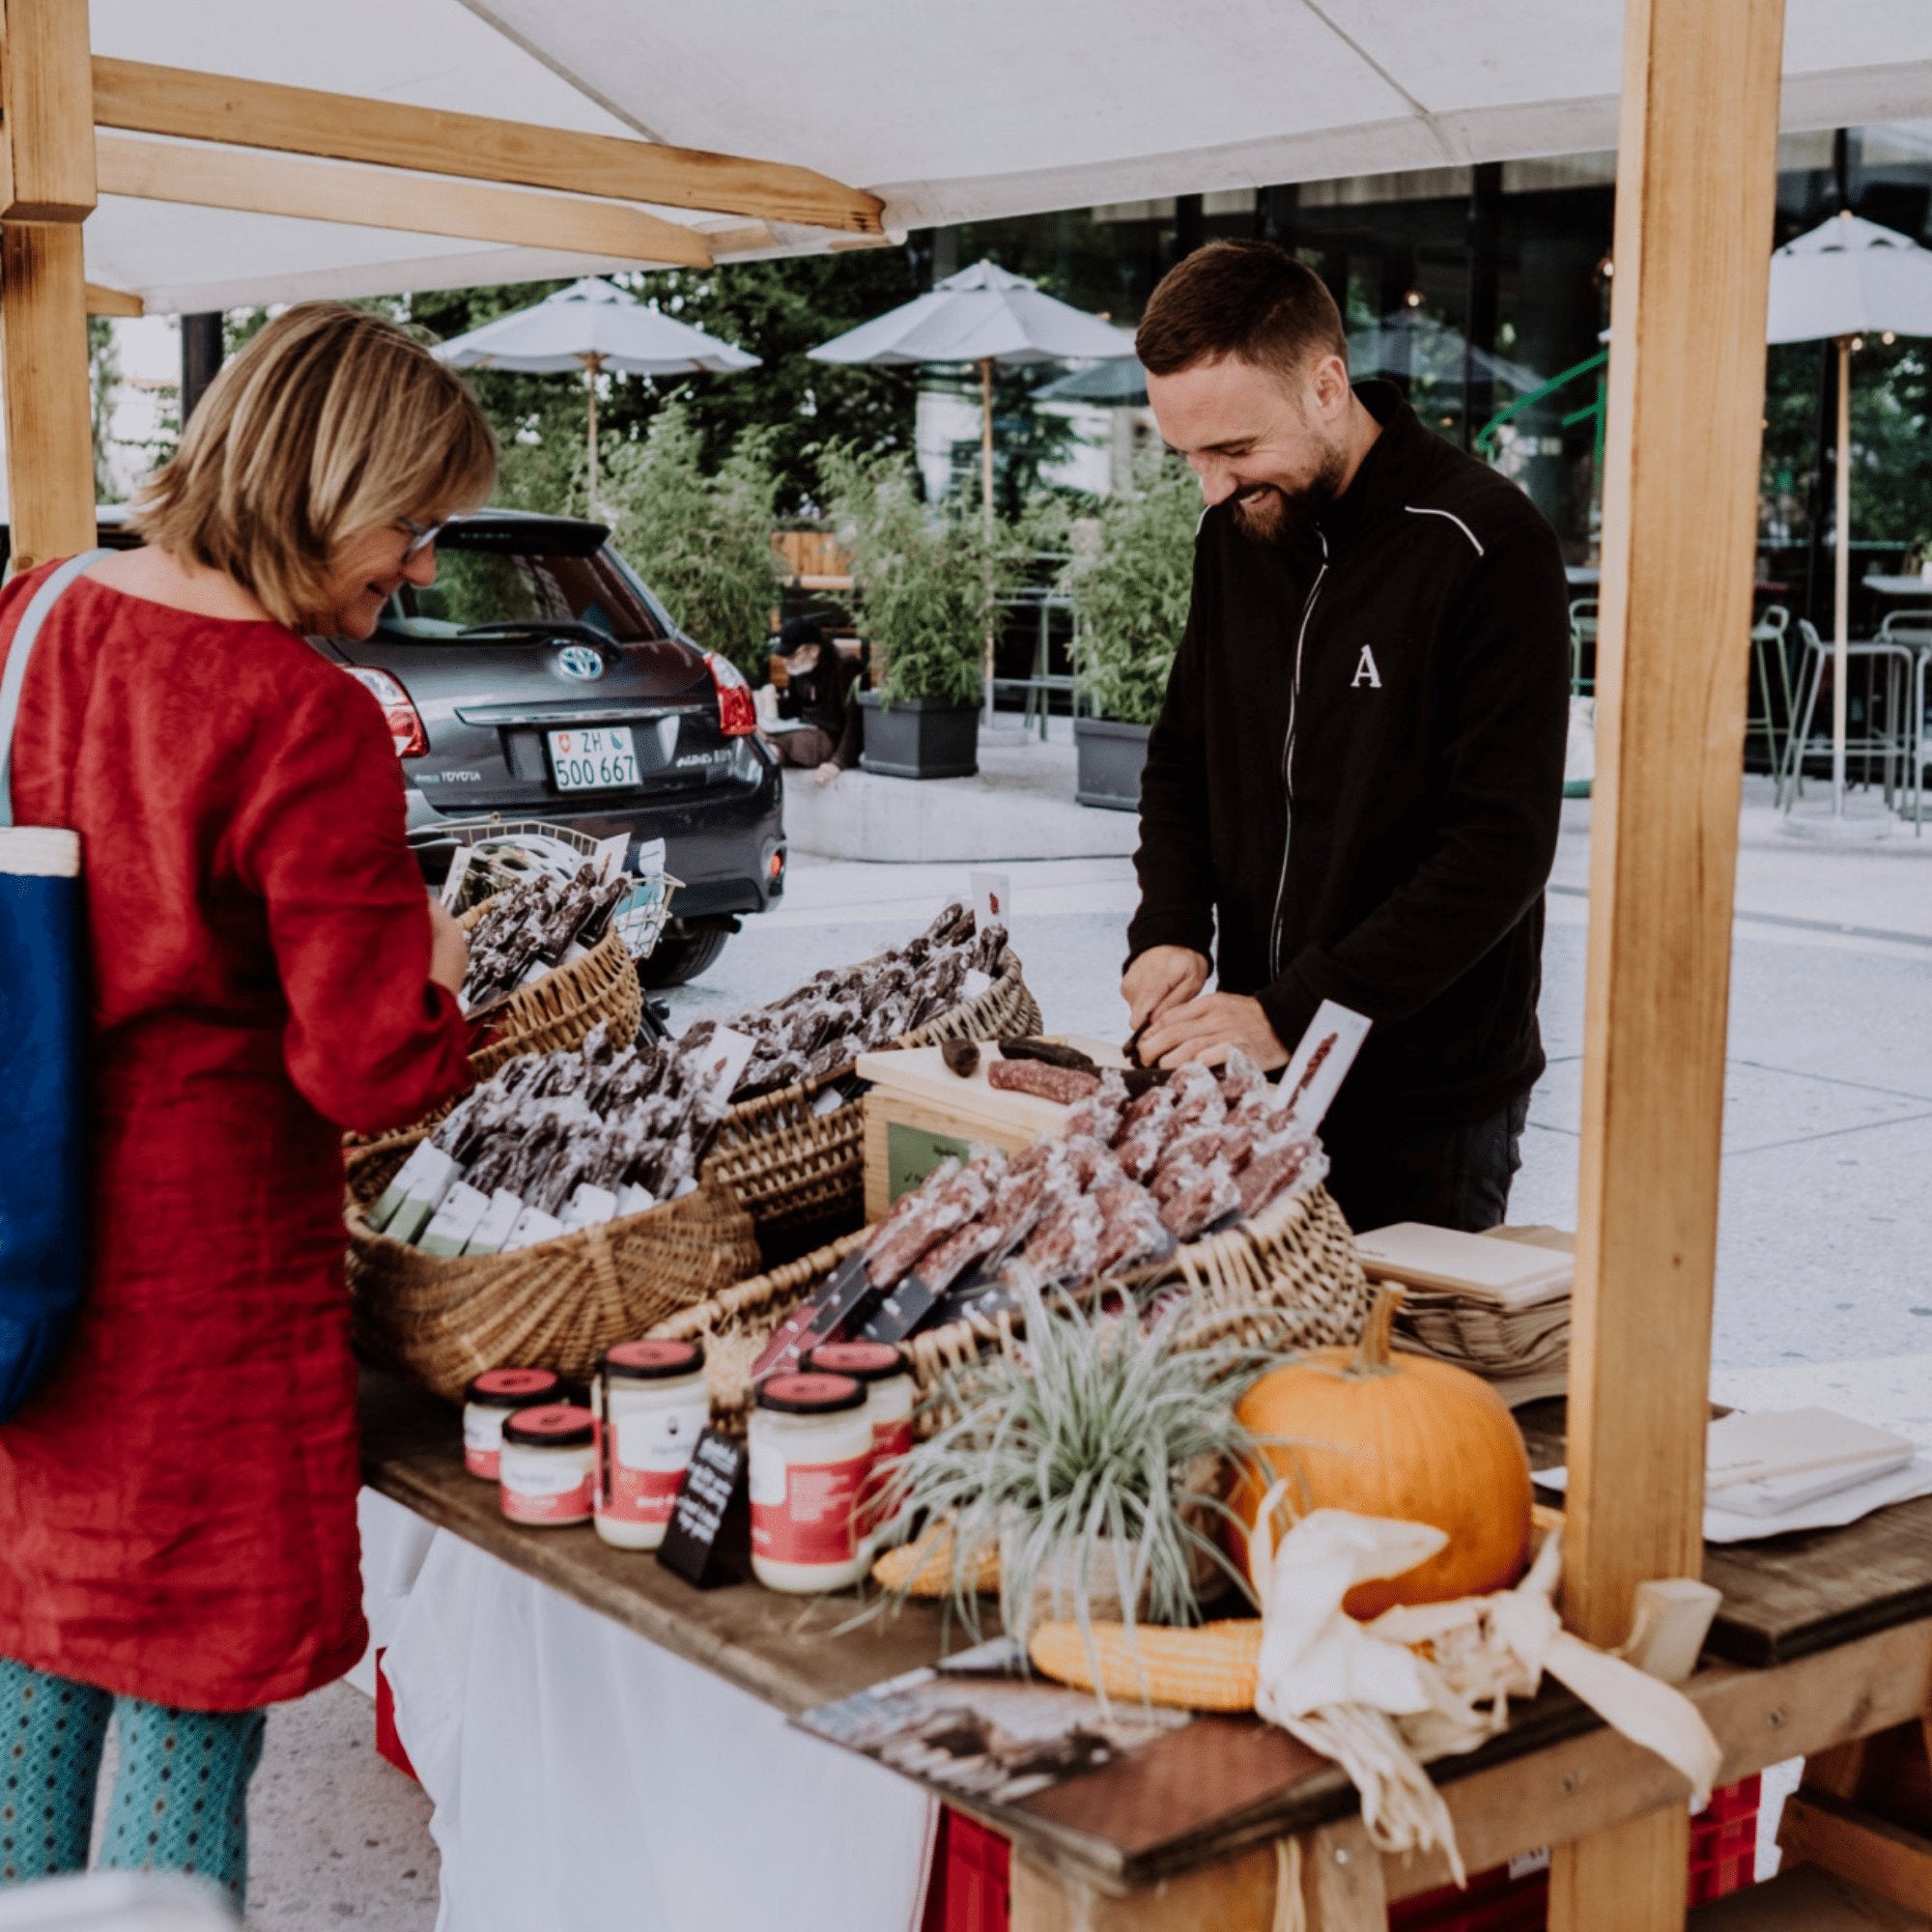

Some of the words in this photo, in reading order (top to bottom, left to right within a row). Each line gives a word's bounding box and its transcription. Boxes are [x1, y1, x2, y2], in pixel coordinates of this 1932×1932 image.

[1350, 643, 1382, 688] A
[582, 731, 603, 753] ZH
[440, 771, 481, 782] TOYOTA
[556, 758, 594, 786] 500
[600, 755, 634, 783] 667
